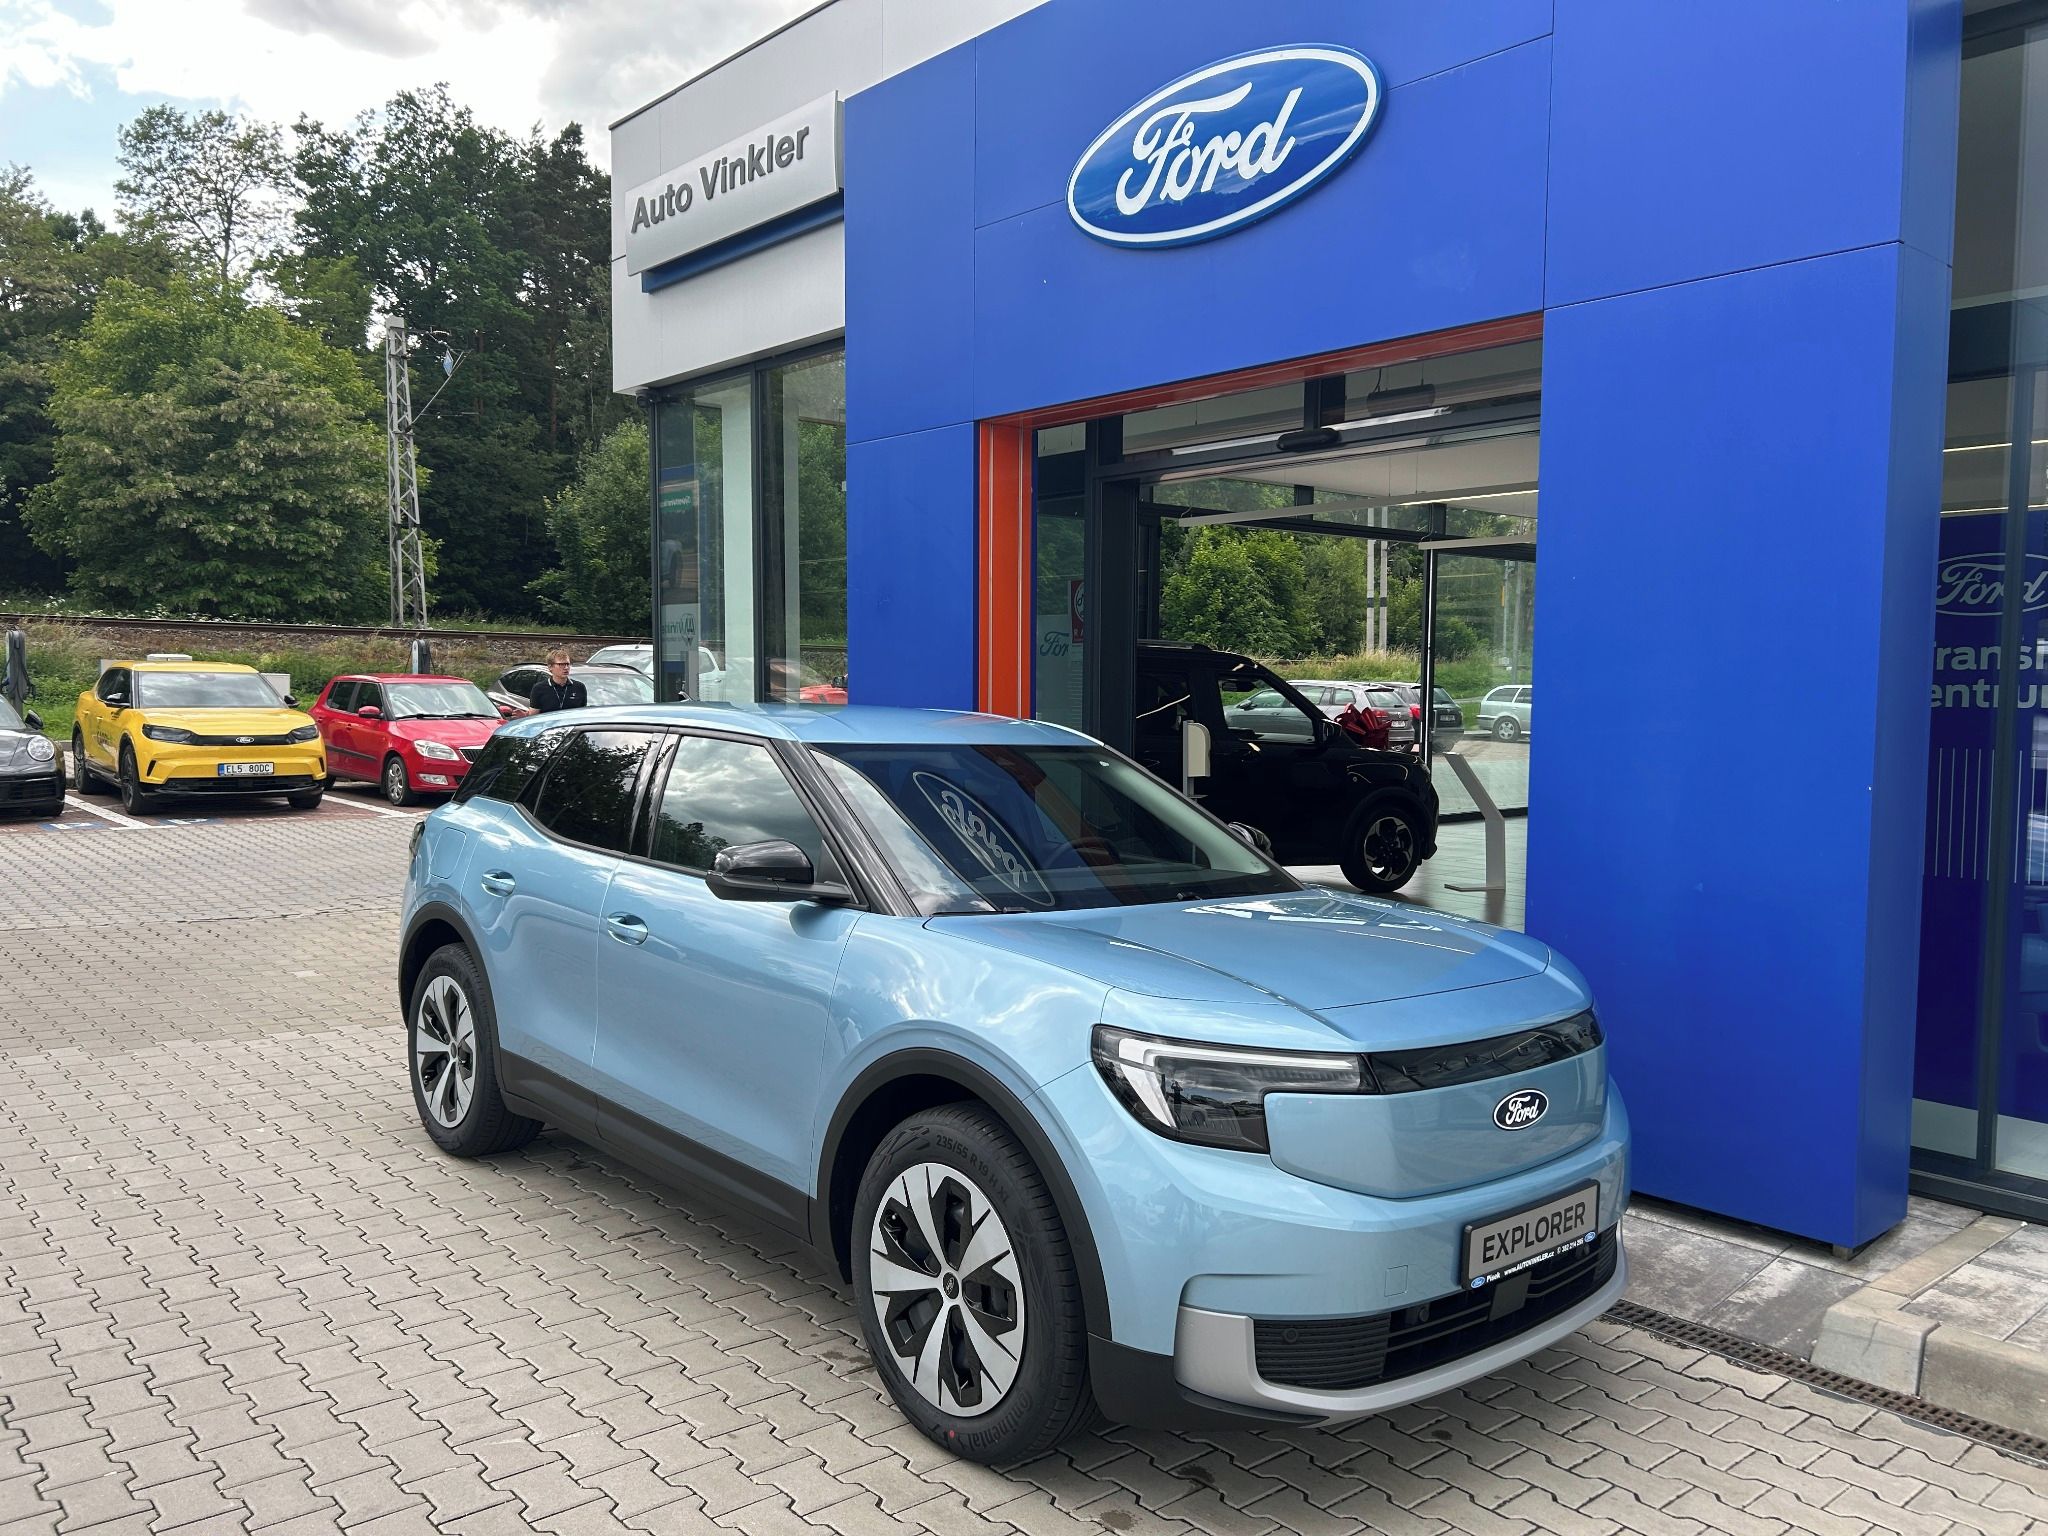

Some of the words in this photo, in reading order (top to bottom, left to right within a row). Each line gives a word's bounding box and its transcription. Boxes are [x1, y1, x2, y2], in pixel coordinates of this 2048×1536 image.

[1115, 82, 1304, 215] Ford
[631, 183, 693, 234] Auto
[699, 126, 810, 200] Vinkler
[226, 765, 243, 774] EL5
[1505, 1095, 1540, 1125] Ford
[936, 1135, 969, 1160] 235/55
[969, 1152, 978, 1167] R
[978, 1161, 989, 1177] 19
[1482, 1201, 1586, 1264] EXPLORER
